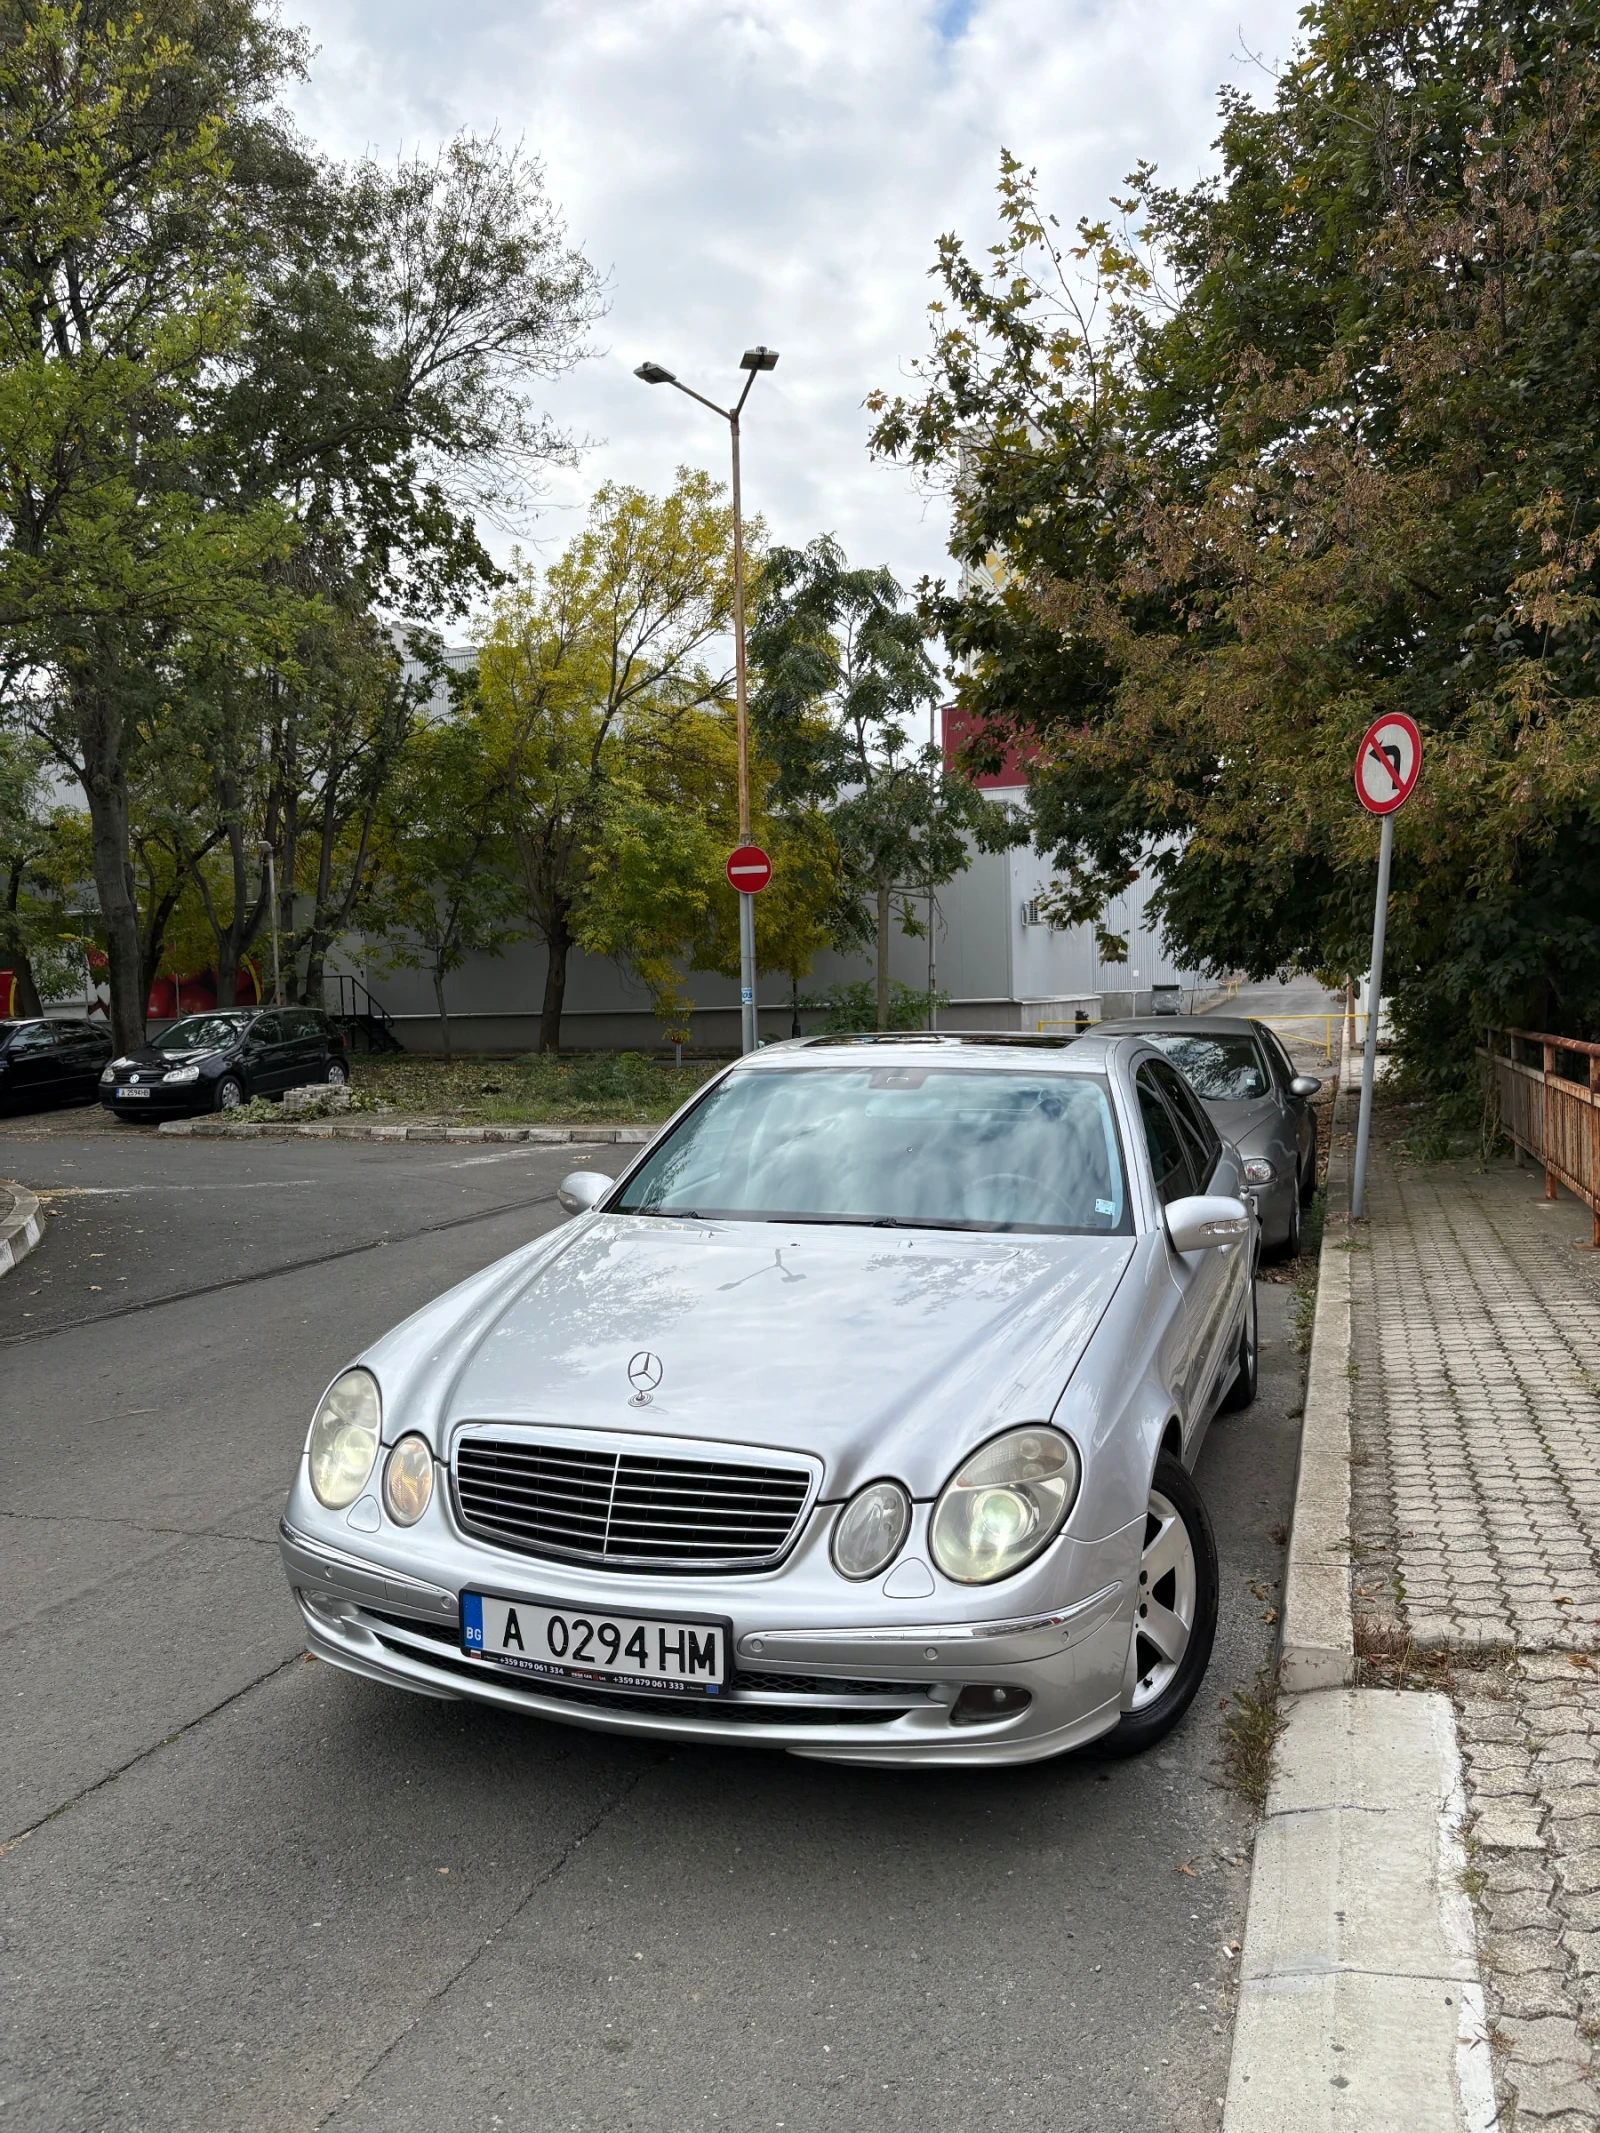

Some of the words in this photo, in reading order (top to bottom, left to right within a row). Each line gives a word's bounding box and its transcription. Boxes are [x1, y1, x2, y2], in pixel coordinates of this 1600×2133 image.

[466, 1626, 482, 1641] BG
[502, 1607, 525, 1651] A
[500, 1657, 518, 1666] +359
[519, 1660, 533, 1669] 879
[534, 1663, 548, 1672] 061
[549, 1666, 564, 1675] 334
[613, 1676, 634, 1685] +359
[635, 1678, 650, 1687] 879
[651, 1680, 667, 1688] 061
[668, 1682, 685, 1690] 333
